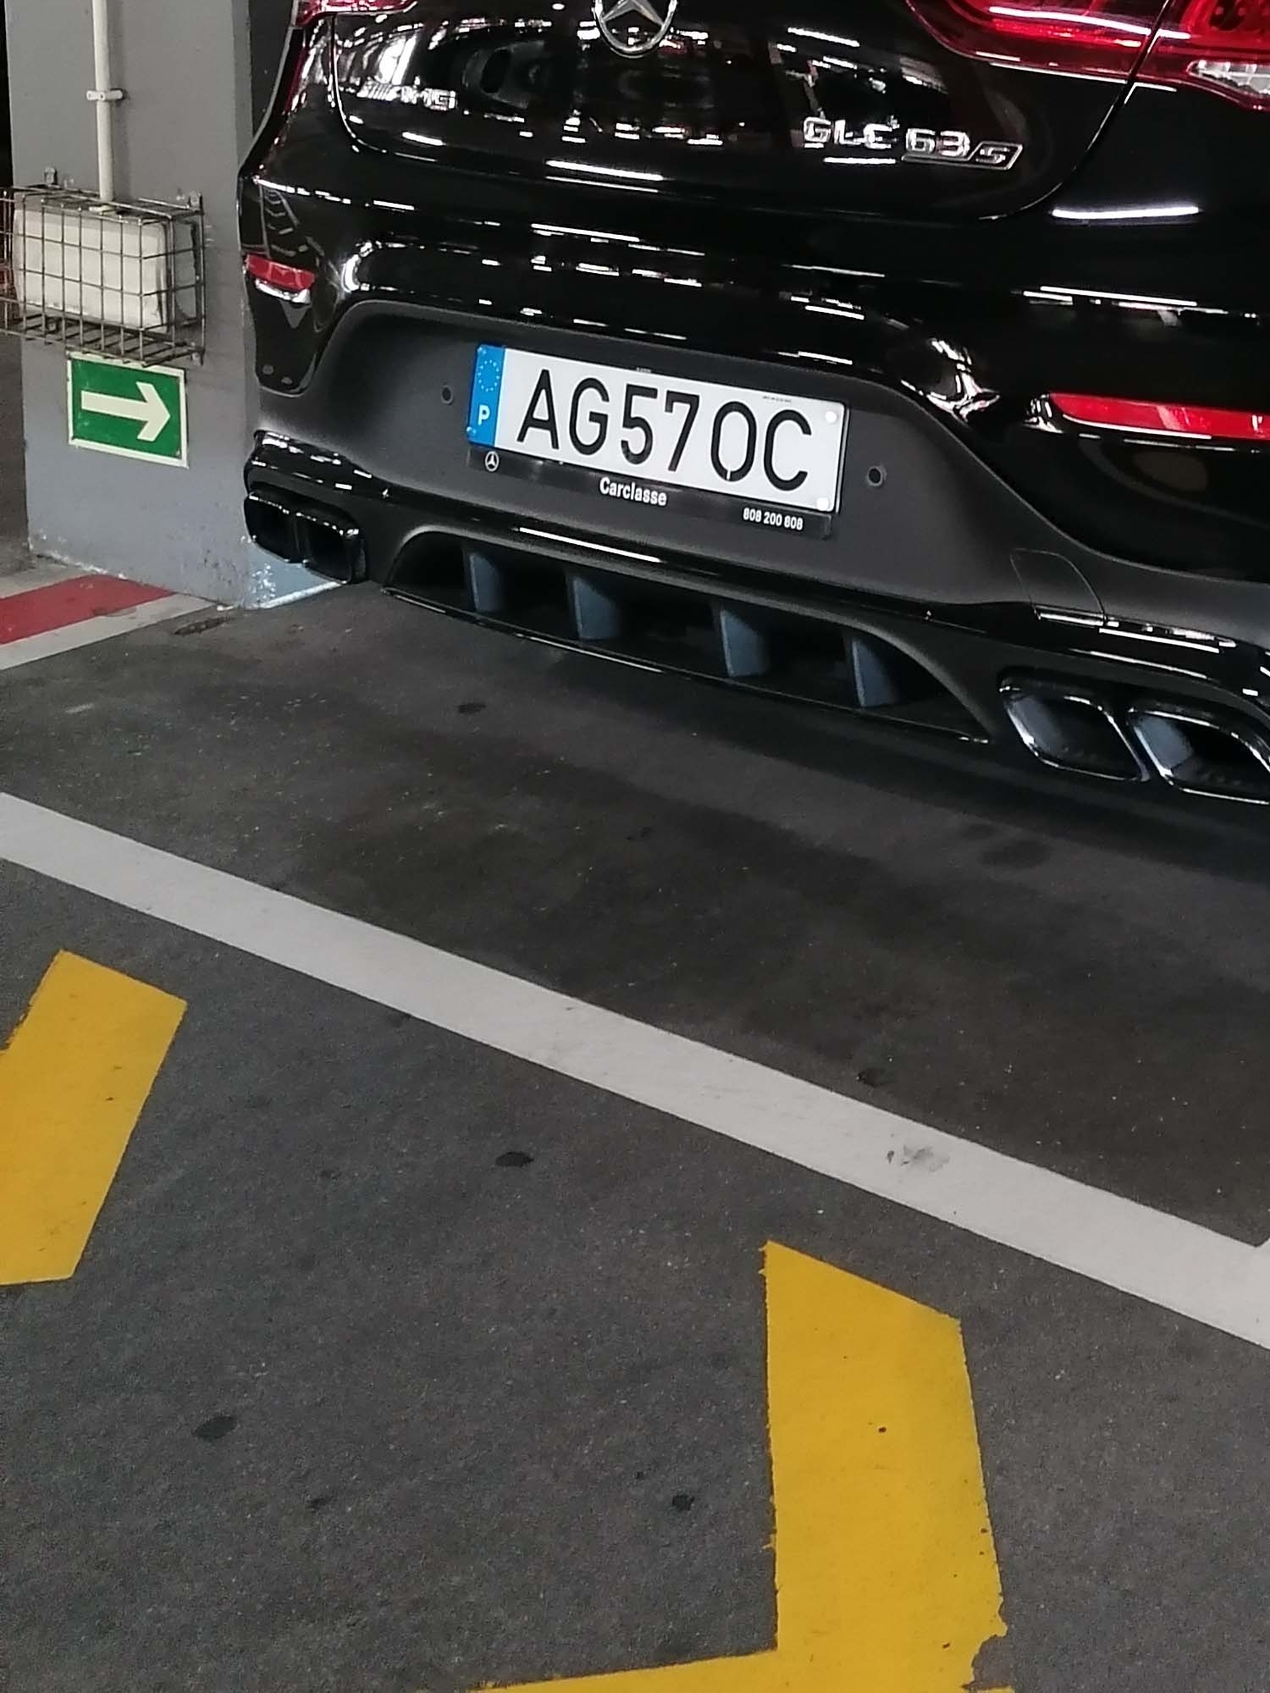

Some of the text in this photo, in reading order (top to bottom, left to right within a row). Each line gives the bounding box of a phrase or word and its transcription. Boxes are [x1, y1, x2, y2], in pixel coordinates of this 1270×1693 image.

[477, 404, 490, 426] P
[599, 476, 668, 507] Carclasse
[742, 507, 804, 531] 808 200 808
